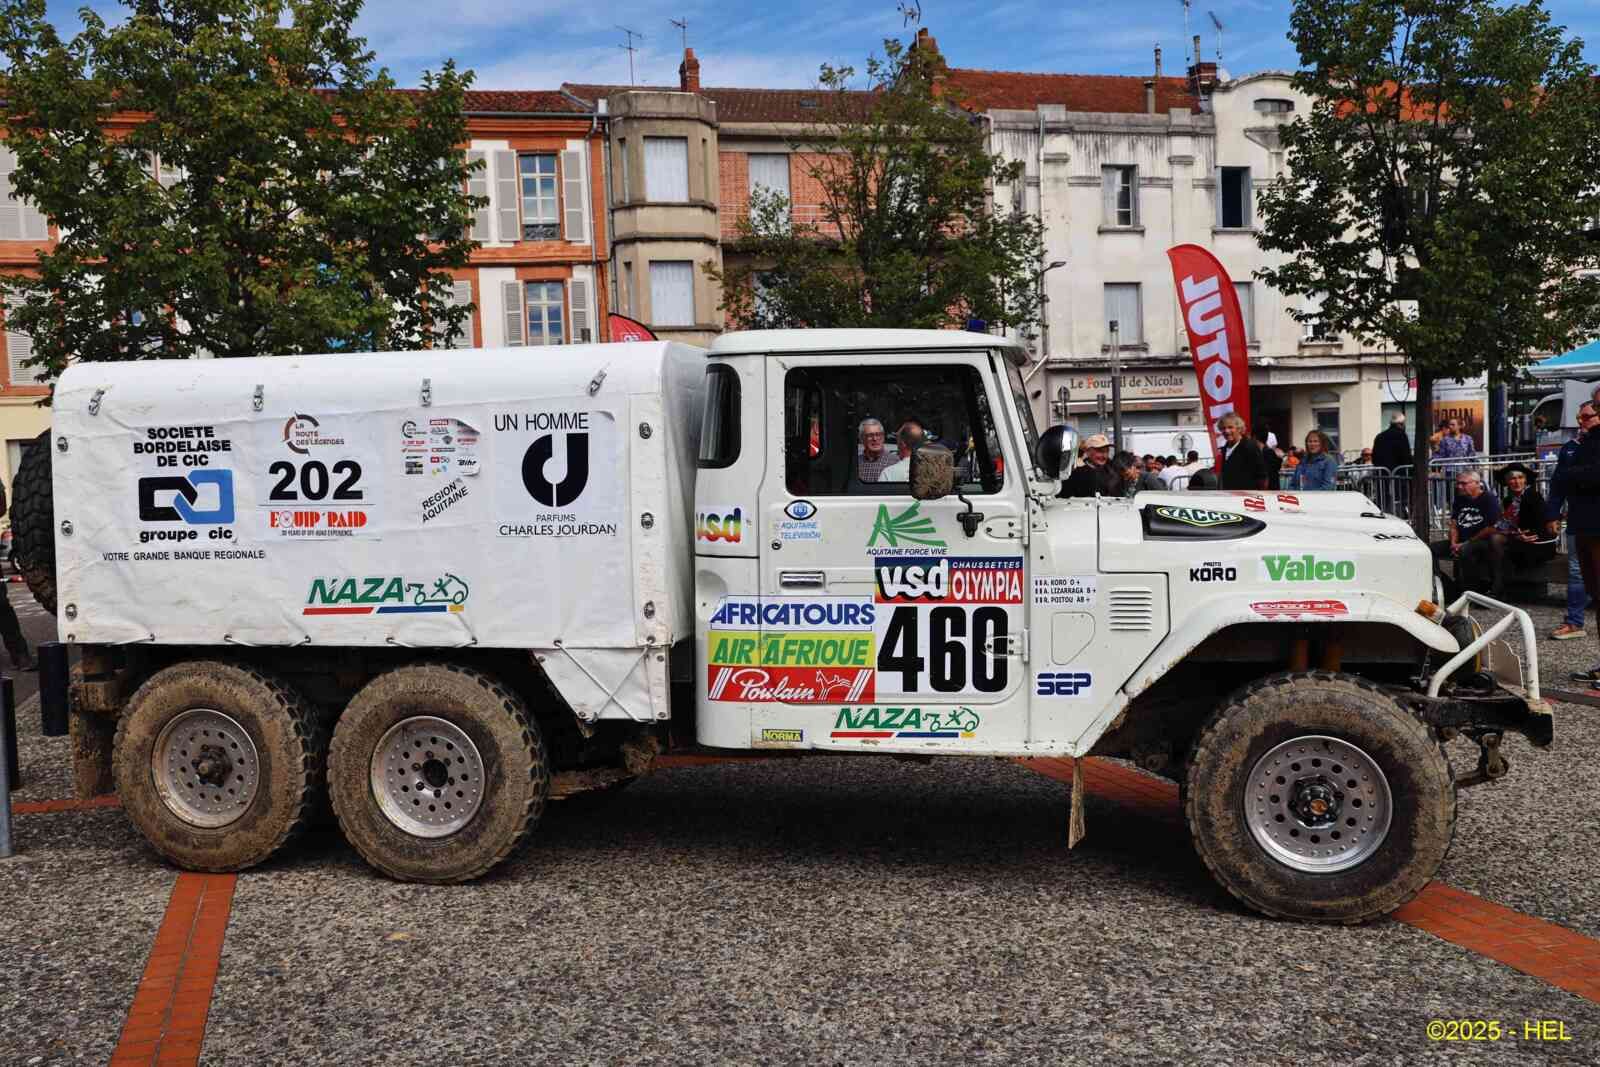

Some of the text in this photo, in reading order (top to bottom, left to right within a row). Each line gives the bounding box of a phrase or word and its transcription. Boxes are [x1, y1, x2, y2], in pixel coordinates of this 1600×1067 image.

[1070, 374, 1184, 390] Le Fouril de Nicolas
[494, 412, 589, 432] UN HOMME
[147, 426, 214, 439] SOCIETE
[133, 440, 232, 453] BORDELAISE
[157, 454, 209, 467] DE CIC
[268, 460, 363, 500] 202
[422, 481, 457, 510] REGION
[423, 486, 469, 523] AQUITAINE
[536, 513, 577, 522] PARFUMS
[781, 521, 817, 530] AQUITAINE
[140, 528, 232, 543] groupe cic
[499, 524, 617, 536] CHARLES JOURDAN
[103, 550, 265, 561] VOTRE GRANDE BANQUE REGIONALE
[866, 548, 903, 556] AQUITAINE
[904, 548, 929, 556] FORCE
[952, 561, 1021, 569] CHAUSSETTES
[1189, 567, 1237, 582] KORO
[1261, 555, 1356, 582] Valeo
[881, 558, 949, 598] vsd
[952, 571, 1022, 601] OLYMPIA
[308, 577, 405, 604] NAZA
[710, 603, 876, 626] AFRICATOURS
[712, 638, 870, 666] AIR AFRIQUE
[877, 606, 1009, 693] 460
[731, 668, 816, 700] Poulain
[1037, 672, 1091, 695] SEP
[834, 708, 921, 729] NAZA
[763, 729, 802, 742] NORMA
